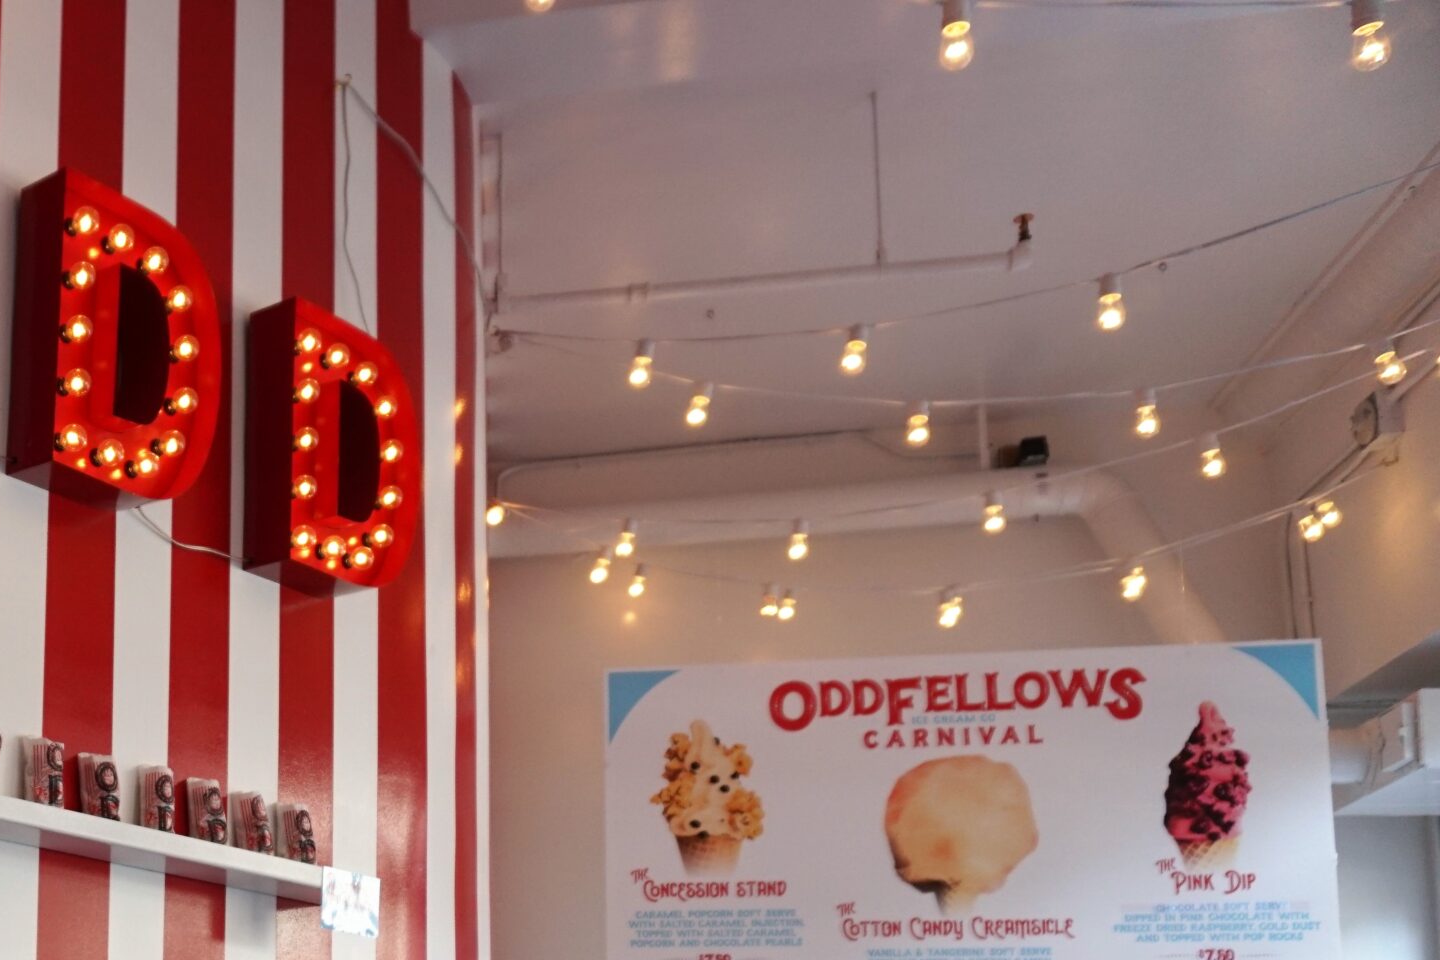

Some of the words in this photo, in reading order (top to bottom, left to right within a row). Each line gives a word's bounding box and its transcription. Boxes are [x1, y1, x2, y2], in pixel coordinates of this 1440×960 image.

[769, 667, 1146, 731] ODDFELLOWS
[864, 725, 1043, 748] CARNIVAL
[1156, 858, 1175, 874] THE
[631, 868, 648, 883] THE
[1171, 871, 1214, 894] PINK
[1224, 870, 1256, 894] DIP
[643, 879, 729, 902] CONCESSION
[736, 880, 787, 897] STAND
[688, 910, 733, 918] POPCORN
[837, 902, 855, 917] THE
[629, 920, 655, 929] WITH
[698, 919, 747, 928] CARAMEL
[843, 918, 902, 941] COTTON
[910, 917, 963, 940] CANDY
[971, 916, 1075, 939] CREAMSICLE
[677, 929, 703, 937] WITH
[747, 929, 796, 937] CARAMEL
[680, 939, 700, 947] AND
[704, 938, 760, 947] CHOCOLATE
